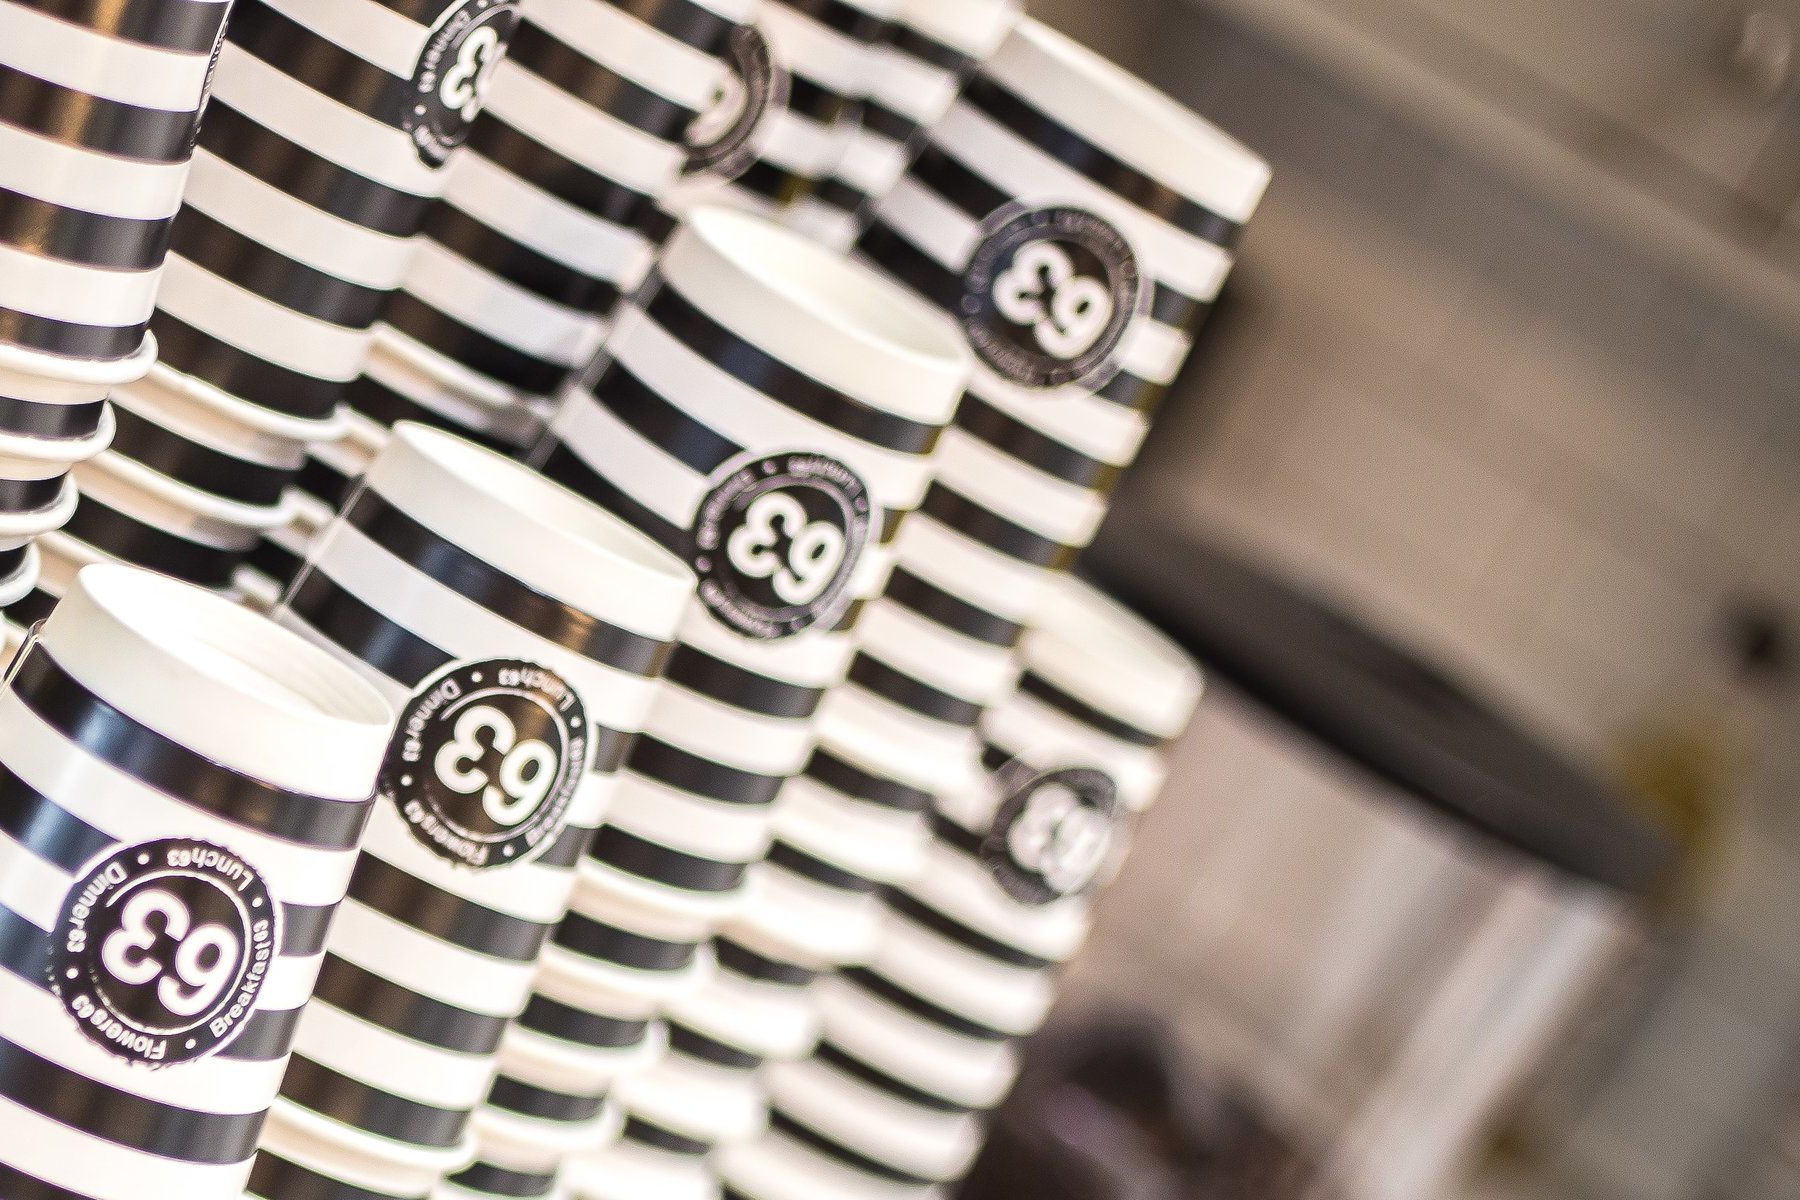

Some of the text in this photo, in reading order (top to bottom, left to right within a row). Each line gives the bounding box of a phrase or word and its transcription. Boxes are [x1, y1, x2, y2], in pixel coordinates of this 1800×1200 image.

[727, 491, 846, 605] 63
[434, 705, 558, 826] 63
[102, 889, 240, 1016] 63
